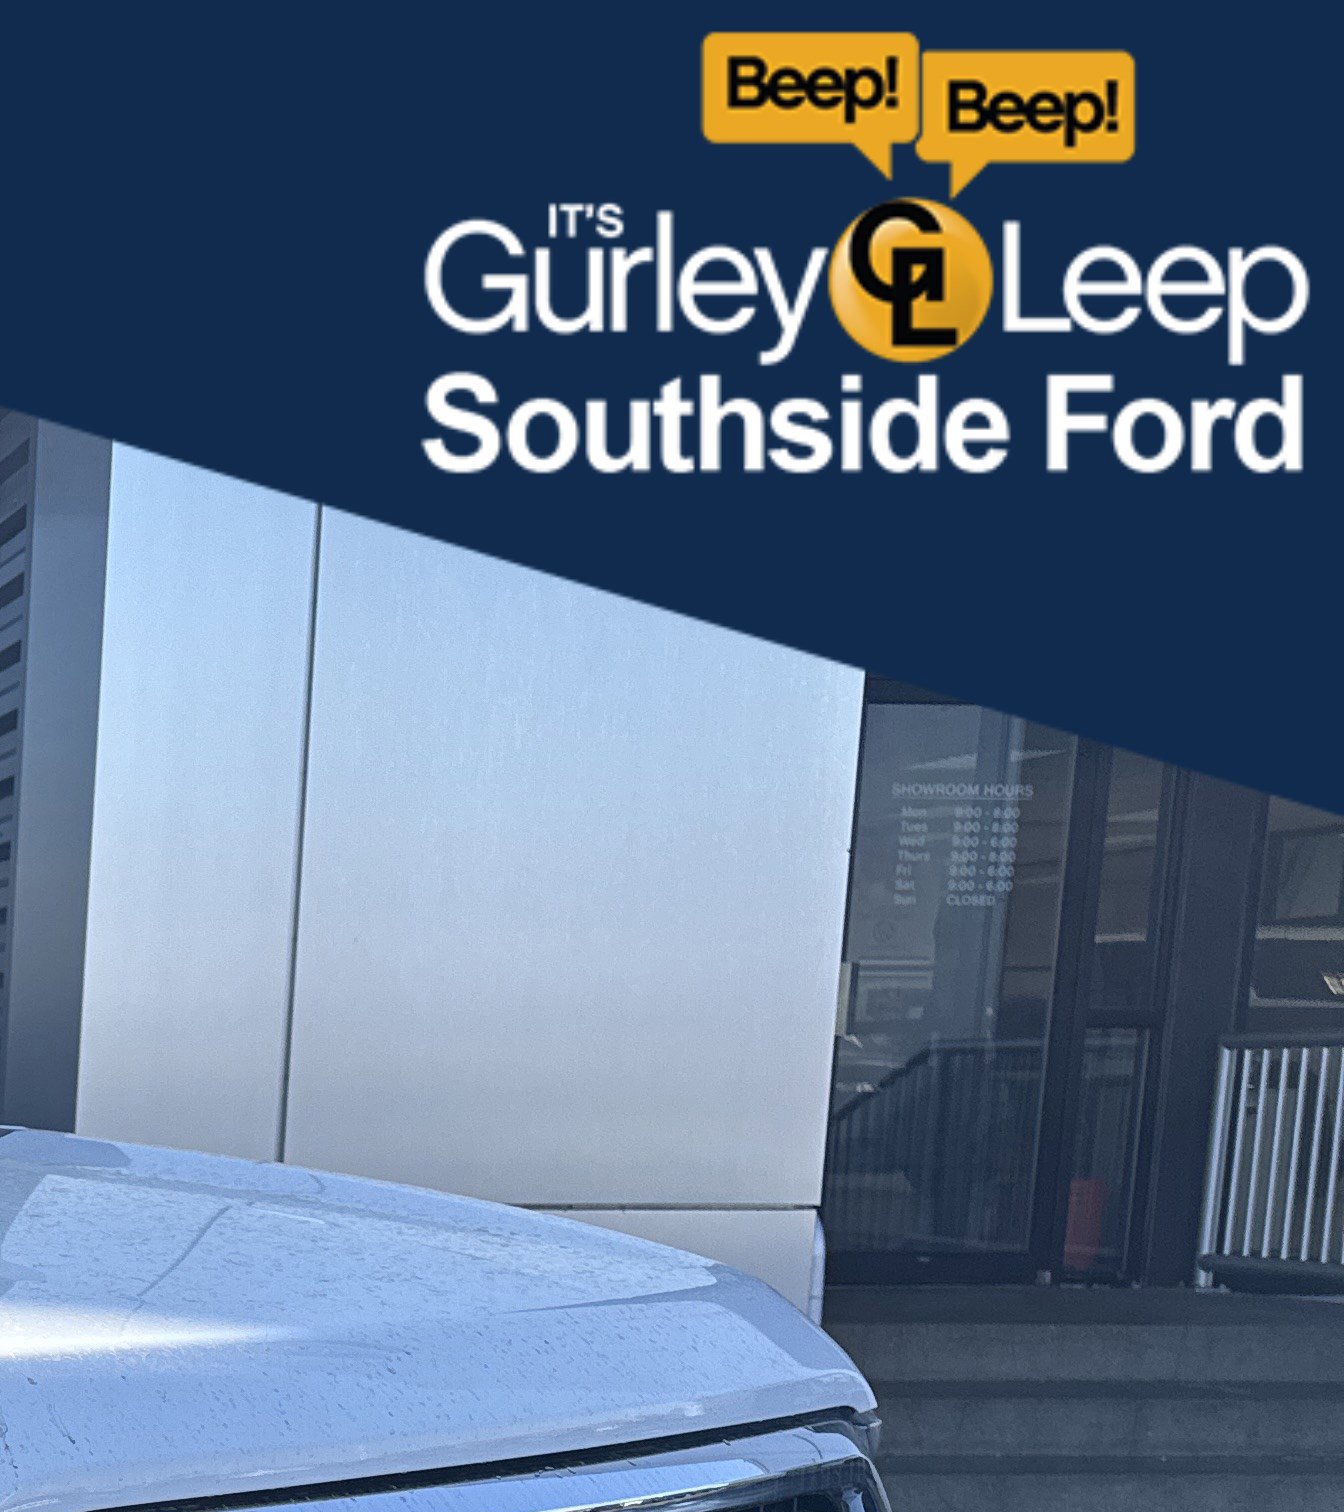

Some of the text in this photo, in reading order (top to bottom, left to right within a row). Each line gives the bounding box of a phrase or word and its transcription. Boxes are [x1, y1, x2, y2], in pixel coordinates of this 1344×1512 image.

[891, 783, 1034, 797] SHOWROOM HOURS
[946, 893, 996, 906] CLOSED
